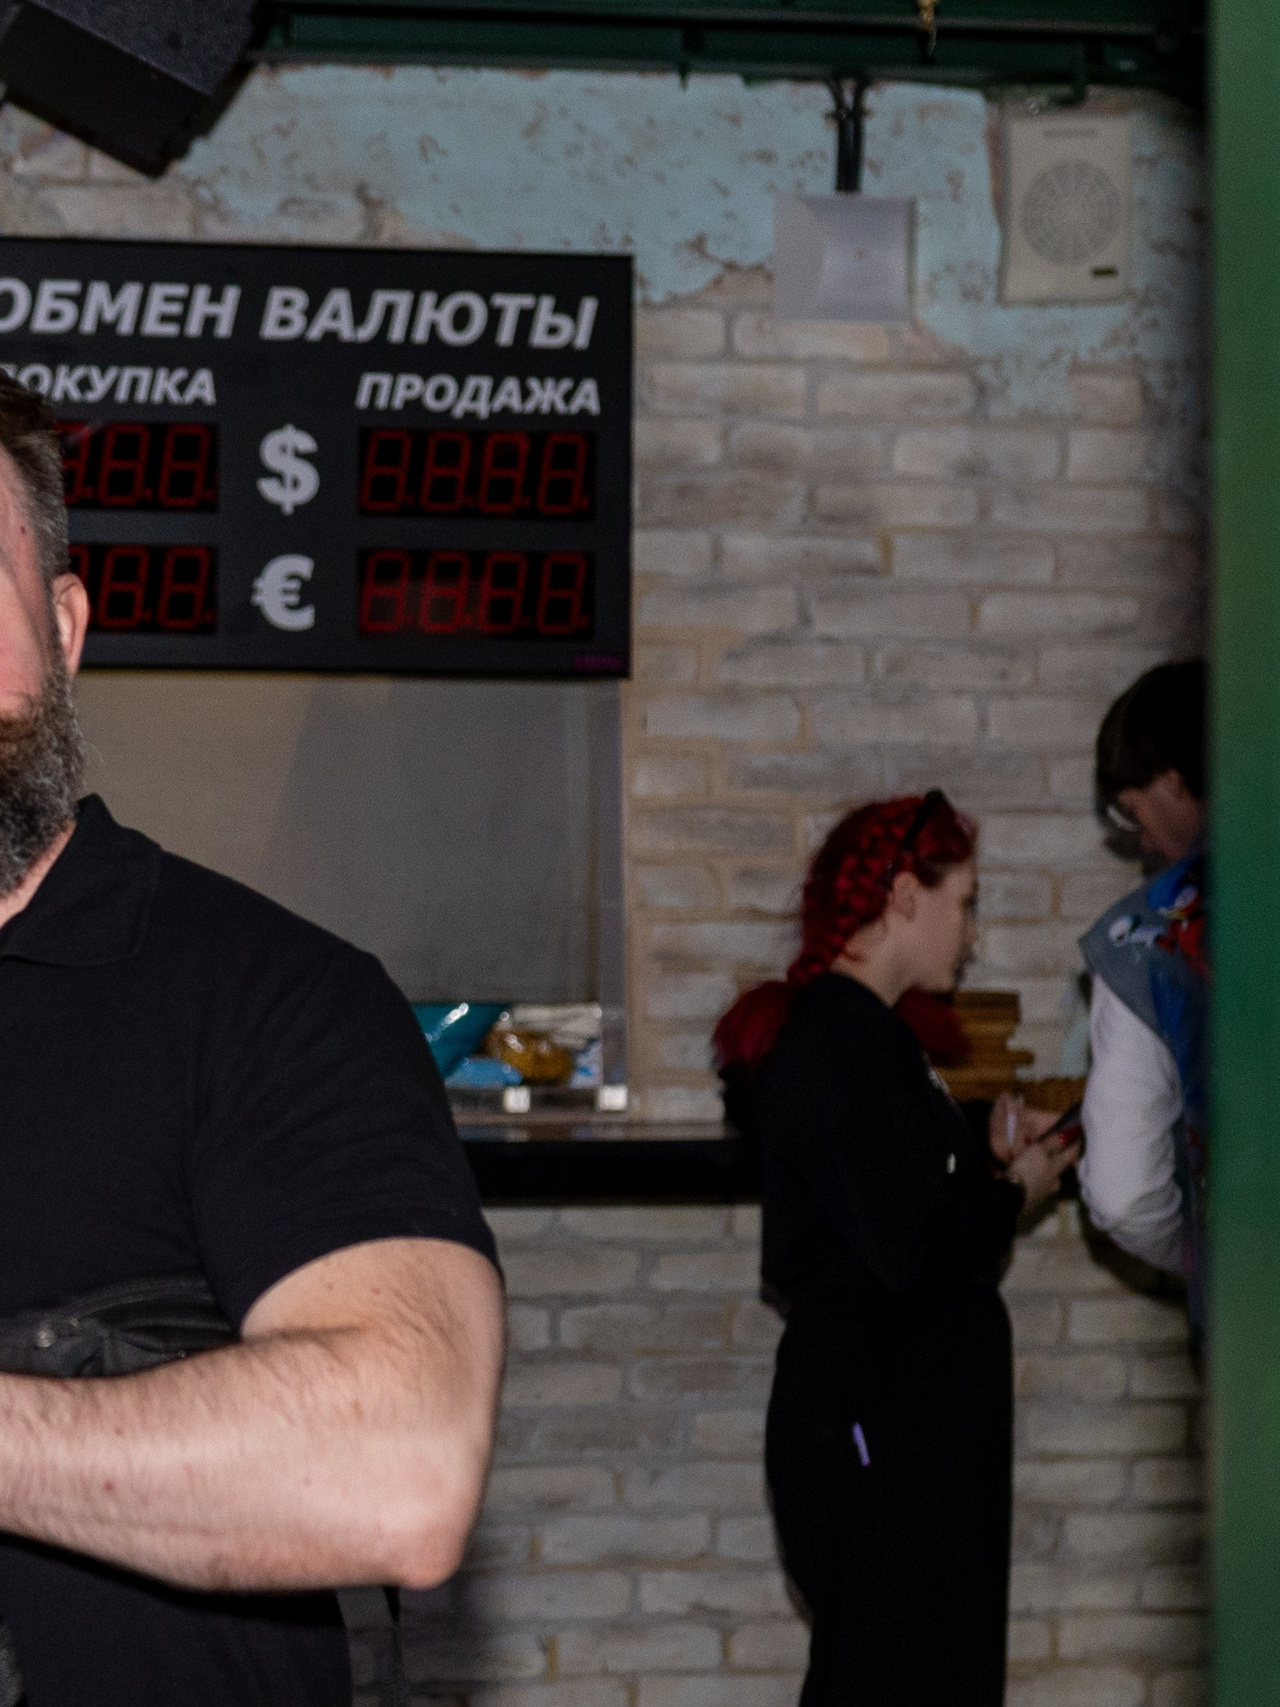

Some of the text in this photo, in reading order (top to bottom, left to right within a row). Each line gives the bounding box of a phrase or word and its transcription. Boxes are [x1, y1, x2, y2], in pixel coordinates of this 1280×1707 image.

[259, 286, 599, 350] ВАЛЮТЫ
[355, 372, 601, 420] ПРОДАЖА
[256, 423, 320, 515] $
[251, 553, 315, 633] €
